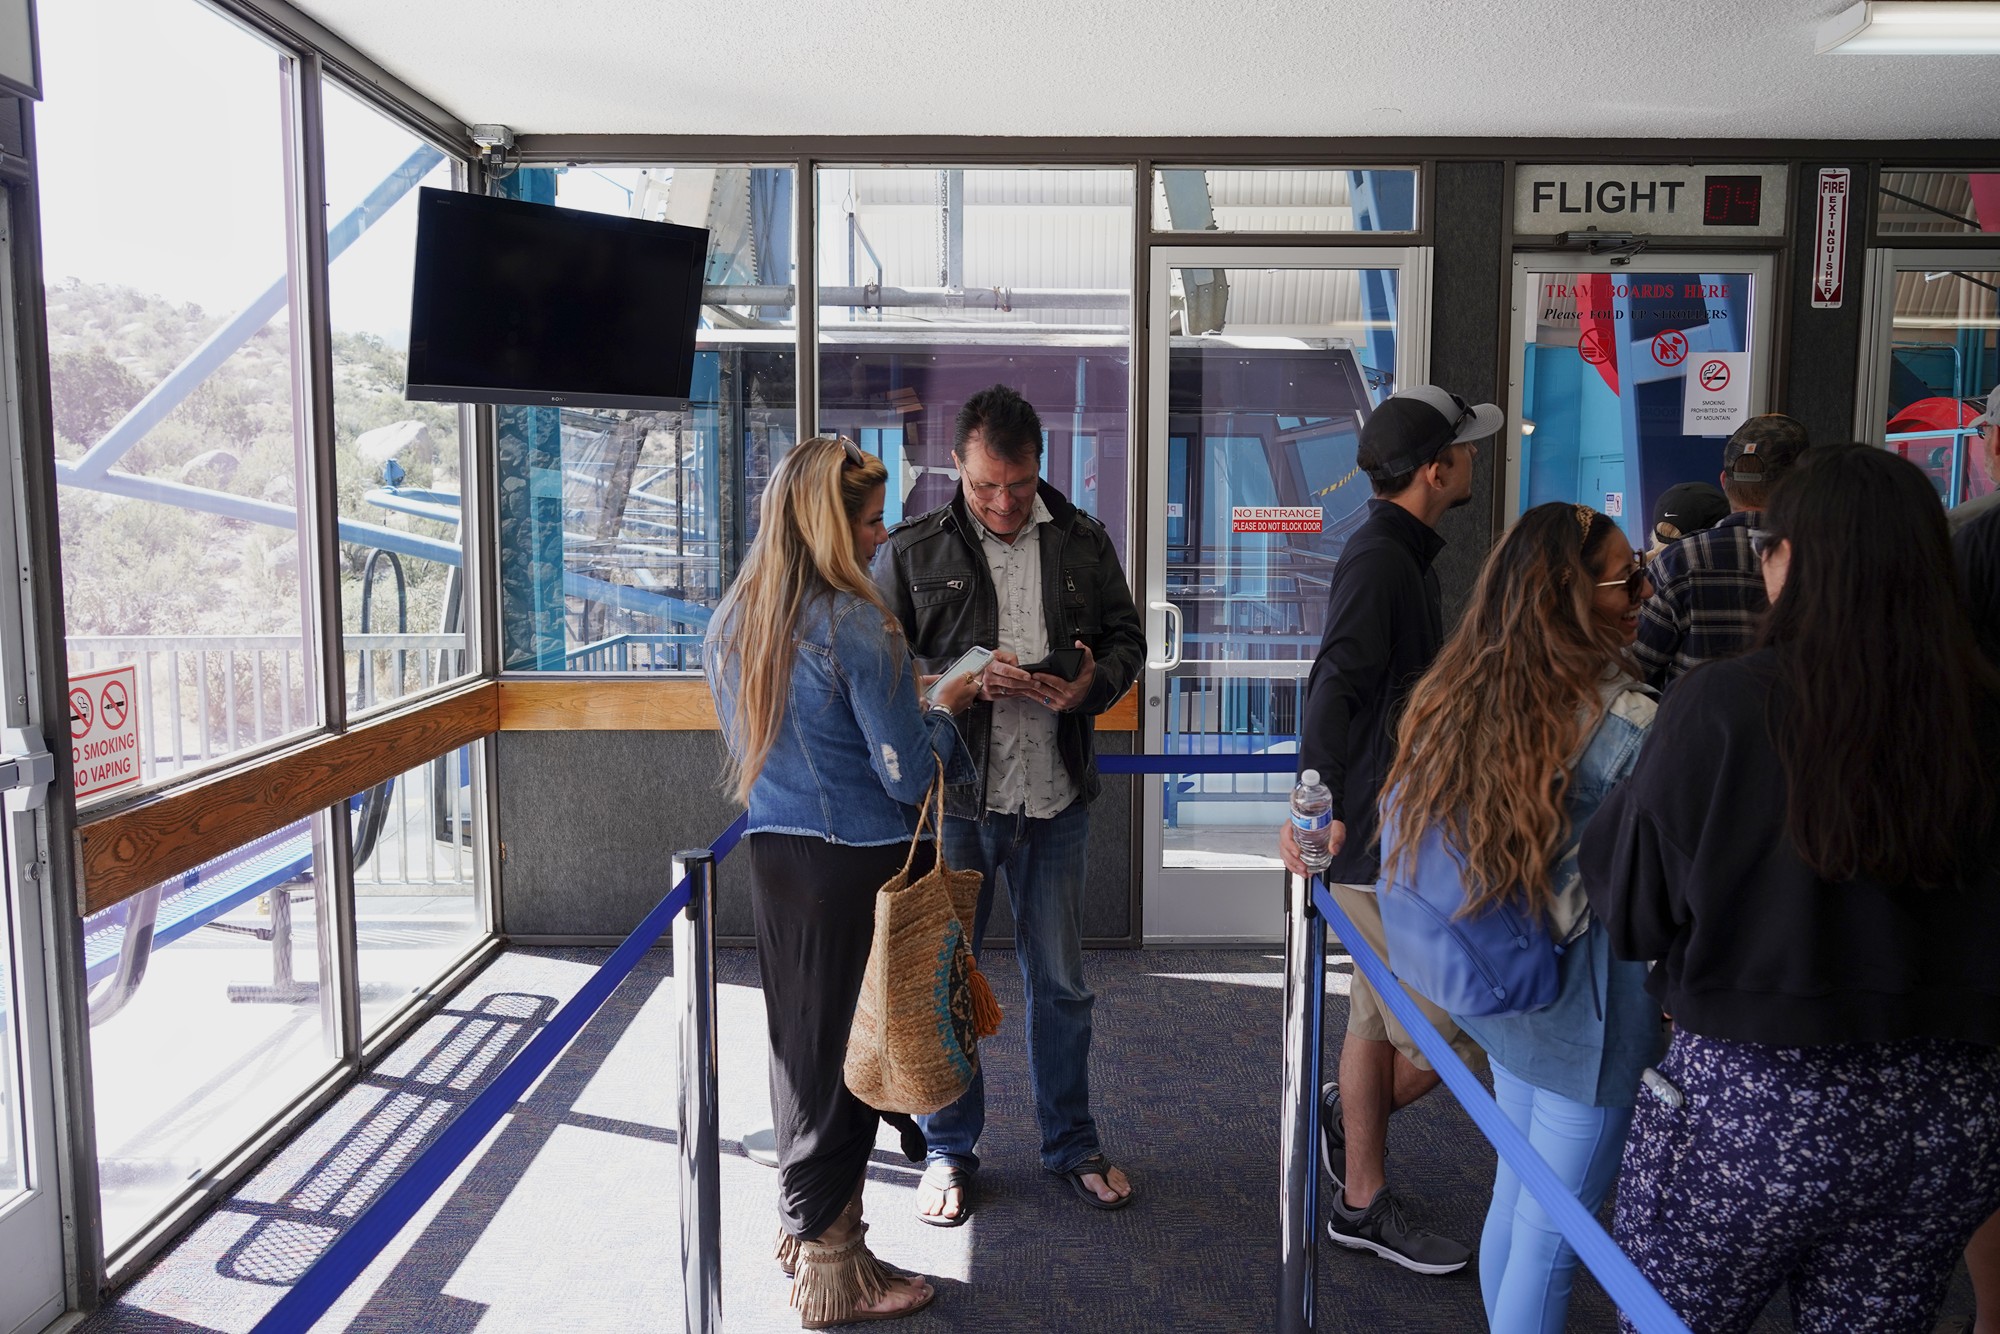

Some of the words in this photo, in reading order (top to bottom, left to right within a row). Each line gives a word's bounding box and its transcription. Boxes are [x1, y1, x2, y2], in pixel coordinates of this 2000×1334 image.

[1532, 180, 1686, 214] FLIGHT
[1823, 181, 1845, 194] FIRE
[1704, 185, 1759, 220] 04
[1824, 196, 1837, 295] EXTINGUISHER
[1545, 284, 1596, 298] TRAM
[1606, 284, 1675, 298] BOARDS
[1684, 284, 1731, 299] HERE
[1543, 308, 1584, 320] Please
[1590, 309, 1625, 320] FOLD
[1631, 310, 1647, 320] UP
[1653, 309, 1728, 320] STROLLERS
[1233, 508, 1252, 518] NO
[1255, 508, 1321, 518] ENTRANCE
[1233, 521, 1257, 531] PLEASE
[1257, 521, 1267, 531] DO
[1267, 521, 1281, 531] NOT
[1281, 521, 1302, 531] BLOCK
[1302, 521, 1321, 531] DOOR
[72, 747, 81, 763] O
[84, 732, 135, 761] SMOKING
[91, 757, 131, 783] VAPING
